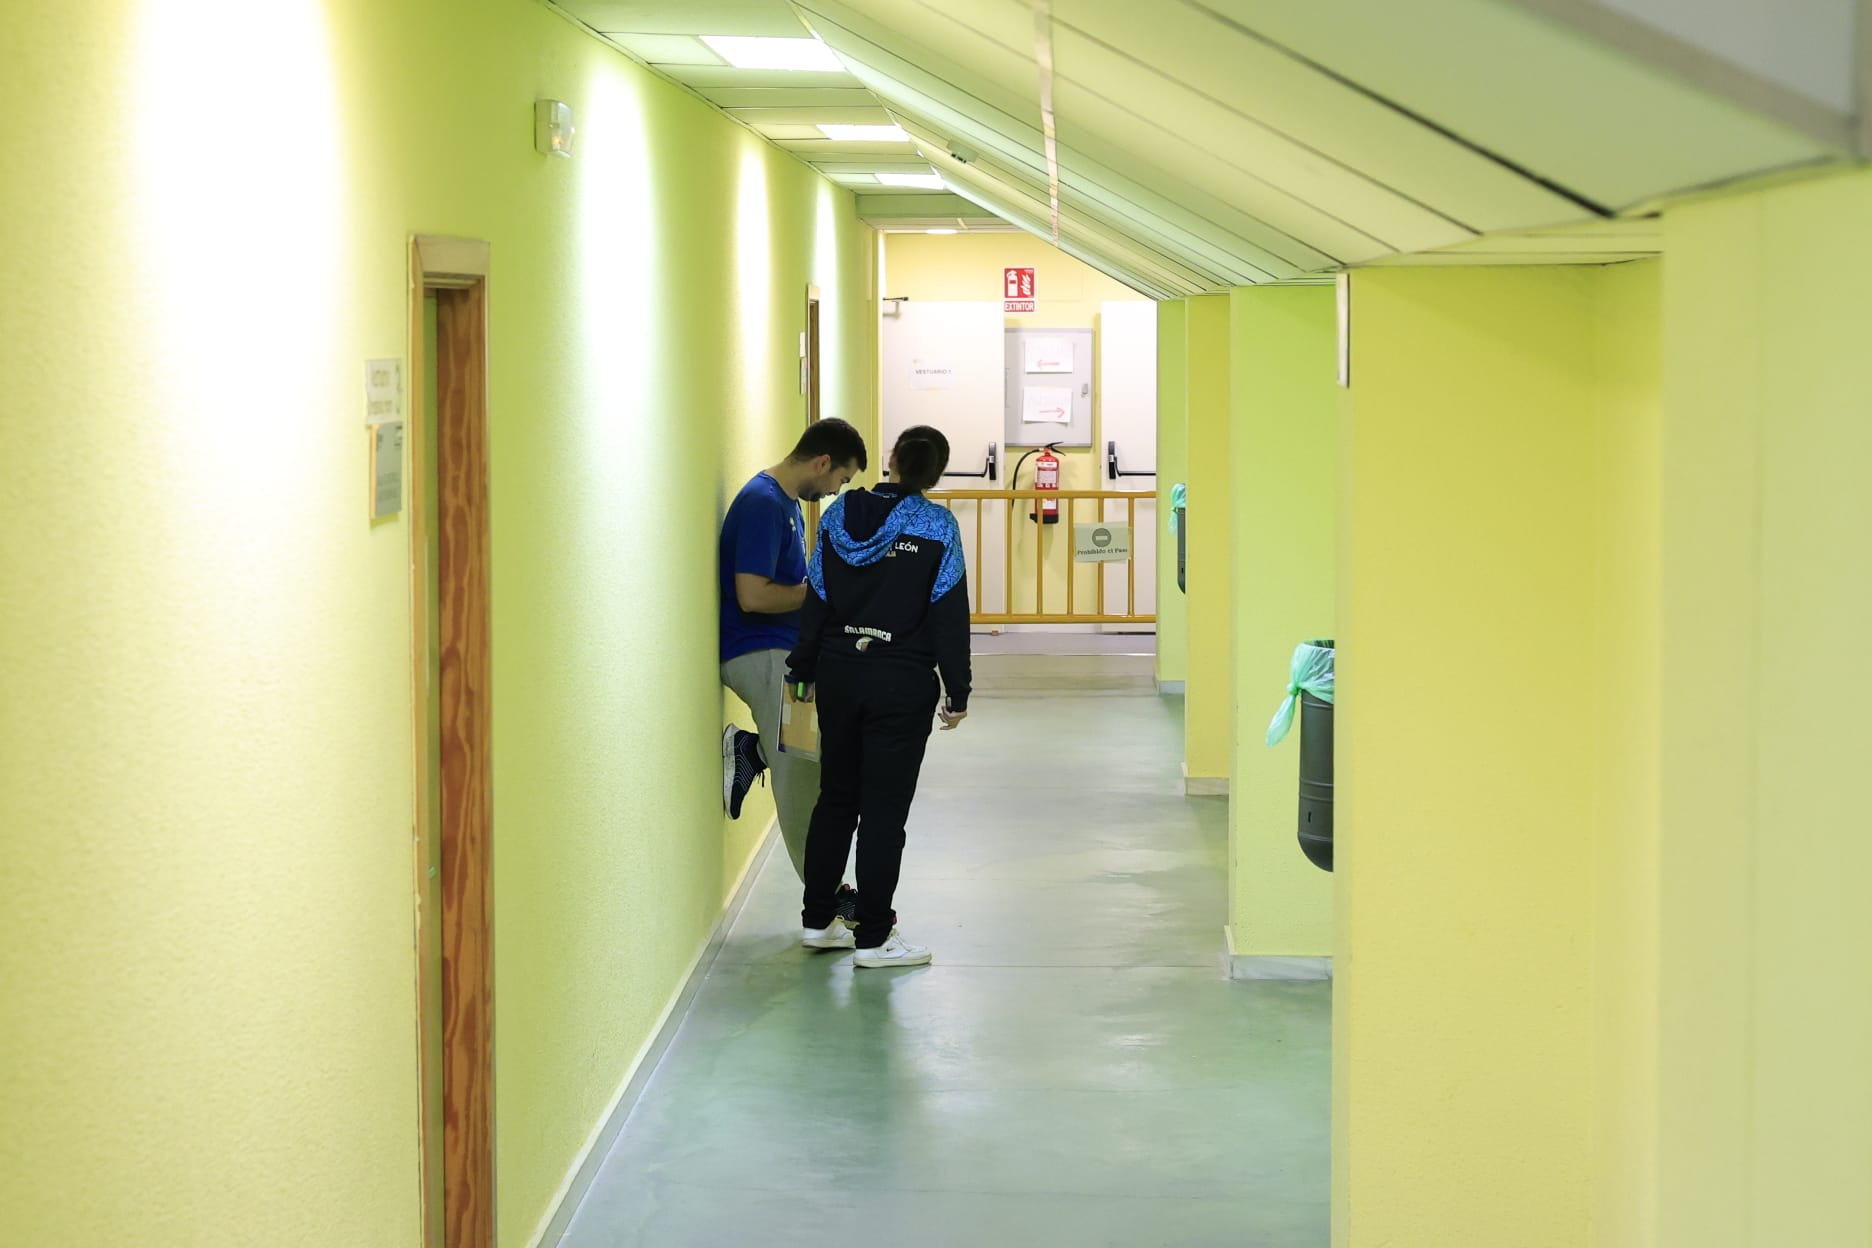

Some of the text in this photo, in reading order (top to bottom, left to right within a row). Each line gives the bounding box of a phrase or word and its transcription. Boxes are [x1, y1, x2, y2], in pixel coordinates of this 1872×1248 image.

[1005, 302, 1033, 311] EXTINTOR
[894, 541, 919, 553] LEÓN
[844, 624, 892, 642] SALAMANCA
